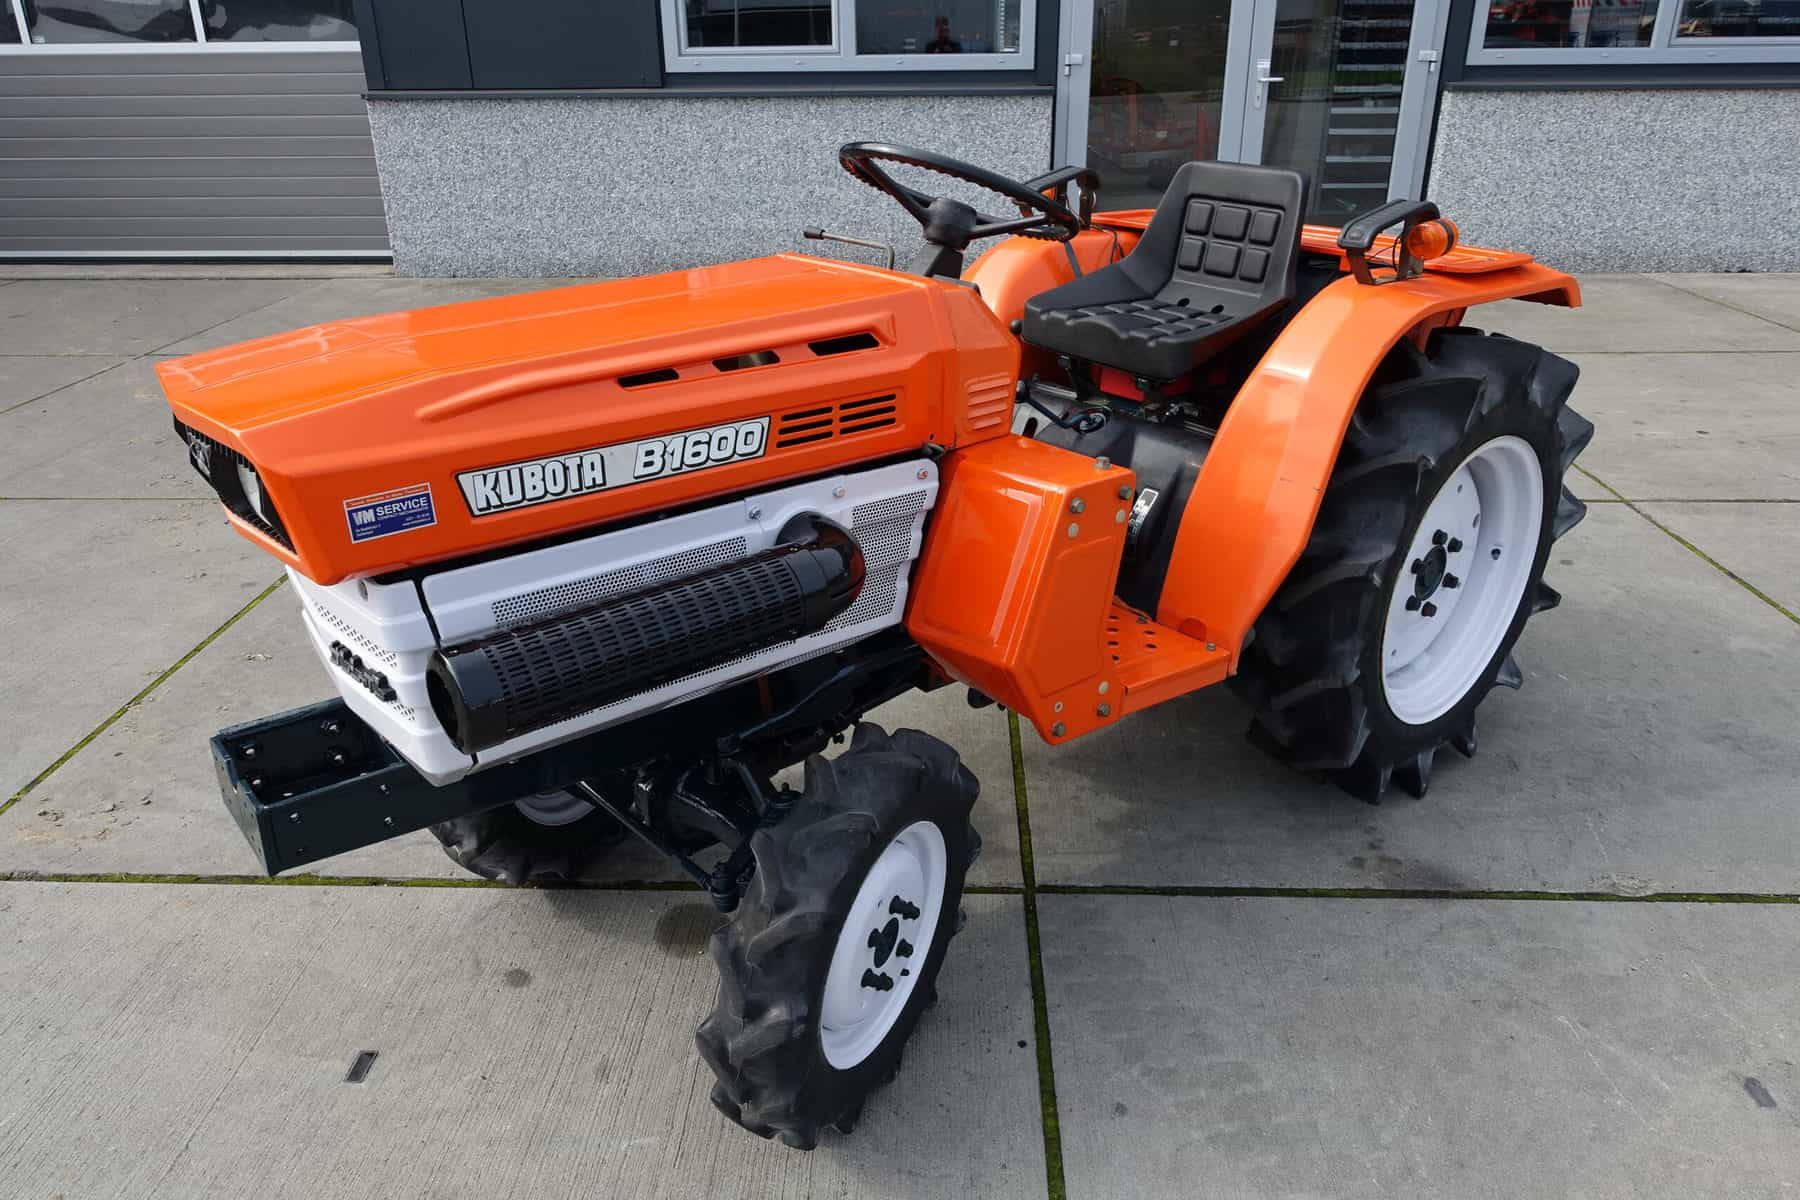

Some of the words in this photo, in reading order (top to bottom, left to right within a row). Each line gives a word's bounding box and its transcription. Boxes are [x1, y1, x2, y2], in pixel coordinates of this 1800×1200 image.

[472, 452, 606, 511] KUBOTA
[633, 421, 764, 479] B1600
[376, 497, 428, 516] SERVICE
